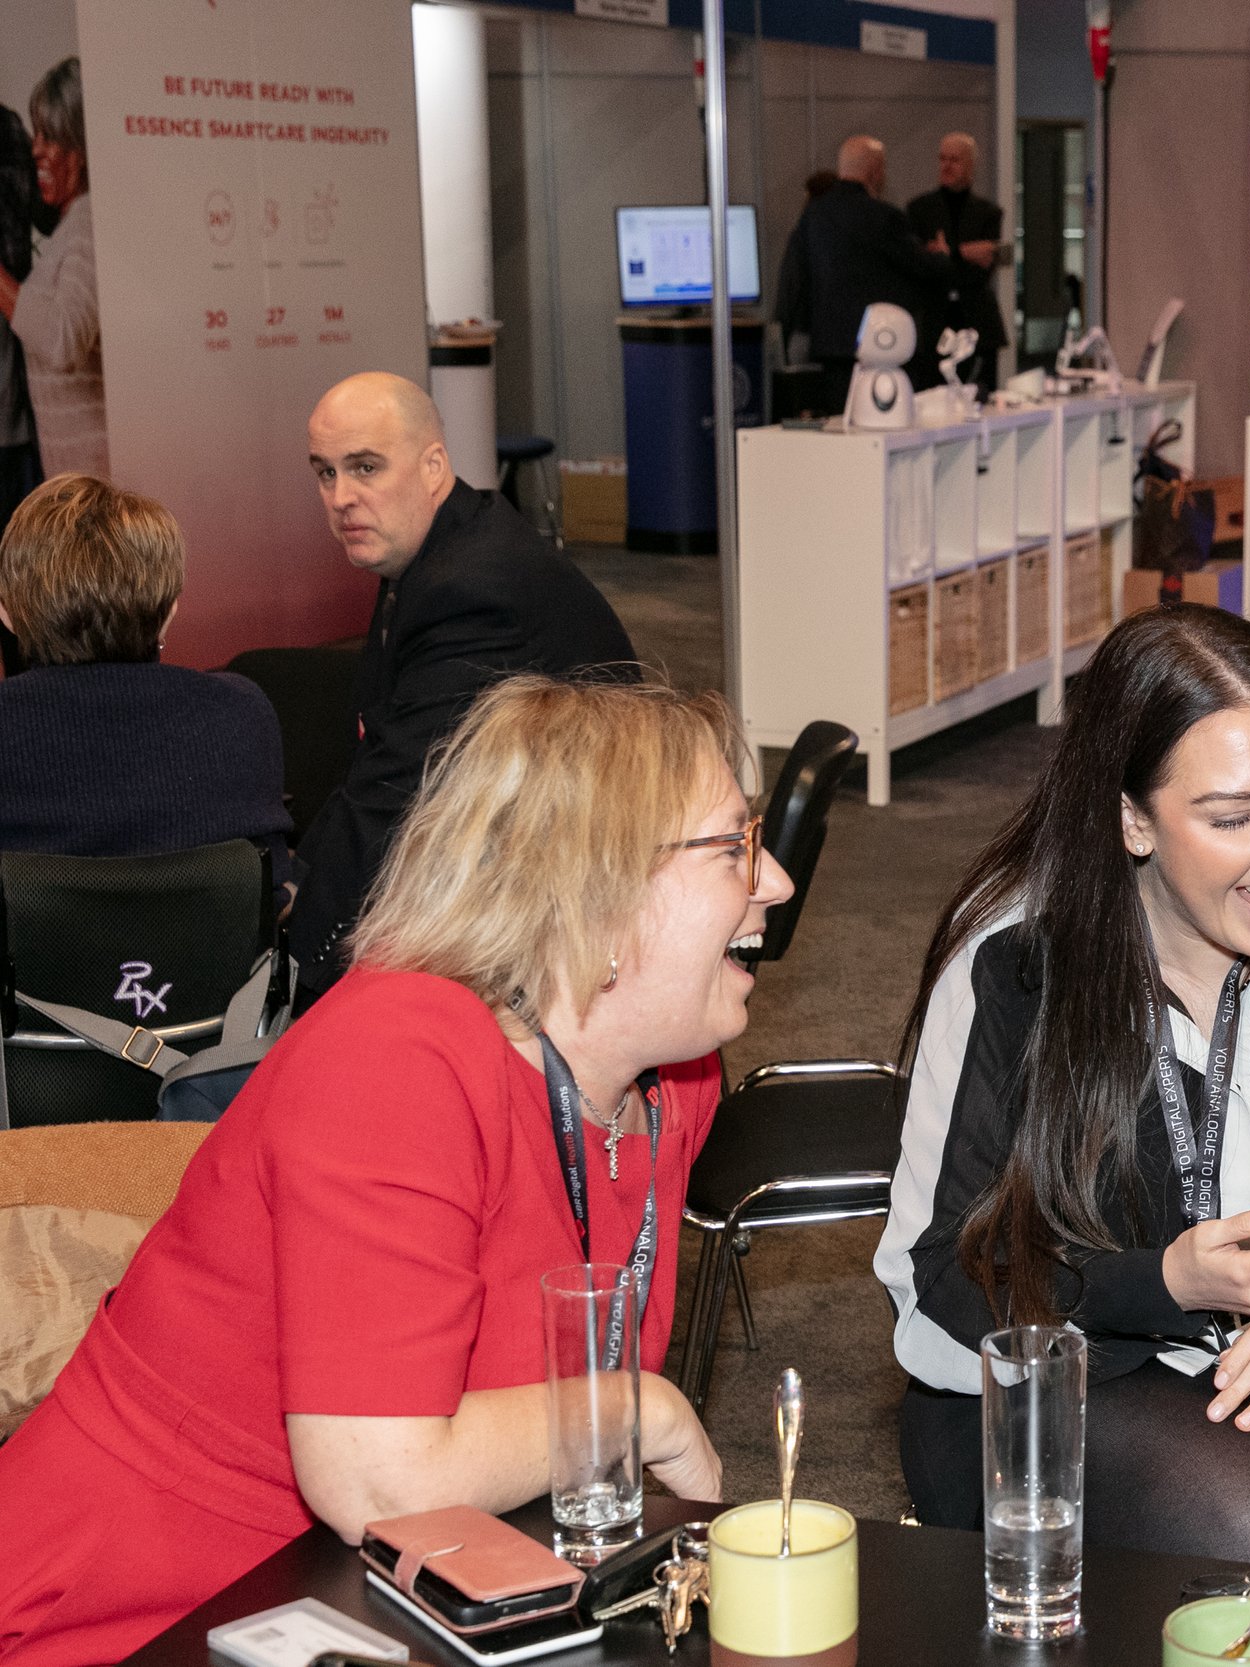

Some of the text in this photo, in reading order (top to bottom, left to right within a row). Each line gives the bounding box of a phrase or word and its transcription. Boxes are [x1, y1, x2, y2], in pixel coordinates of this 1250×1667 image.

[164, 76, 355, 105] BE FUTURE READY WITH
[125, 115, 389, 144] ESSENCE SMARTCARE INGENUITY
[1222, 970, 1240, 1023] EXPERTS
[1158, 1045, 1177, 1101] EXPERTS
[561, 1085, 575, 1132] Solutions
[1167, 1102, 1189, 1152] DIGITAL
[1196, 1048, 1228, 1224] YOUR ANALOGUE TO DIGITA
[571, 1167, 582, 1196] Digital
[1179, 1154, 1192, 1174] TO
[576, 1196, 584, 1219] GBR
[632, 1215, 652, 1292] ANALOG
